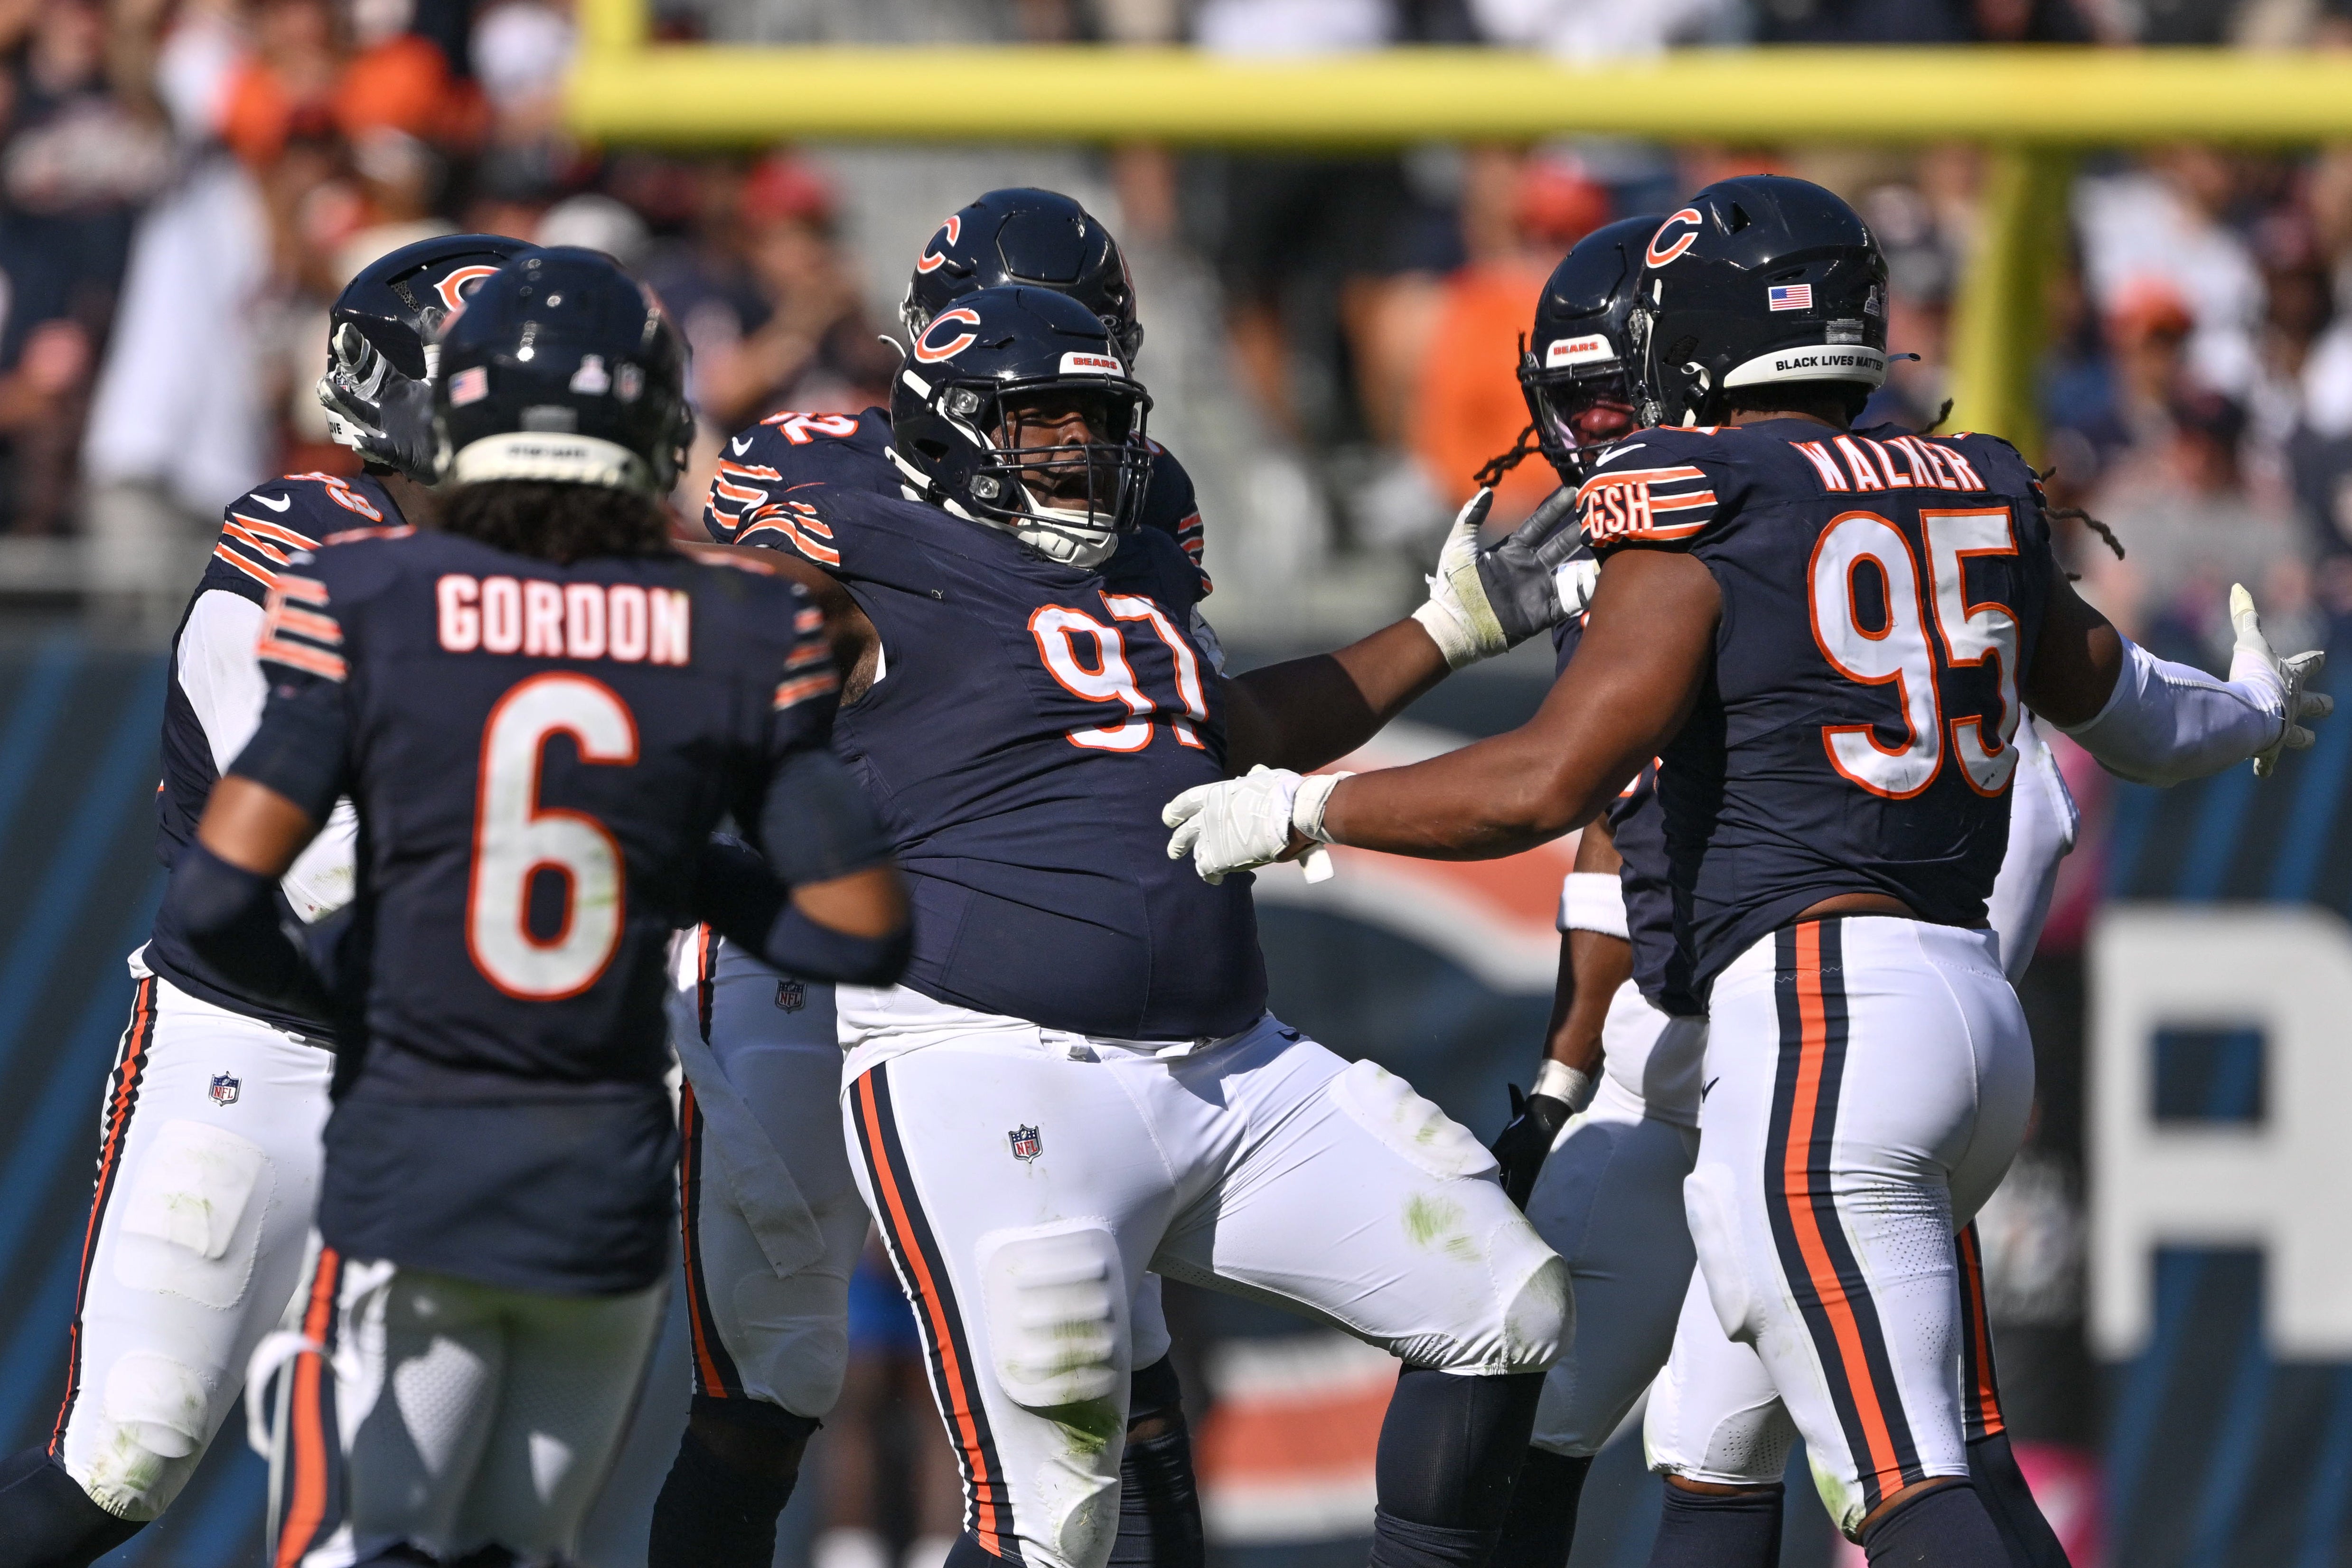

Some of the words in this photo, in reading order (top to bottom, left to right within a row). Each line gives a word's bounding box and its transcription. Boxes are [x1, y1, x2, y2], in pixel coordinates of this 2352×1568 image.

[1646, 208, 1702, 268] C
[914, 308, 981, 363] C
[1554, 341, 1598, 356] BEARS
[1073, 357, 1117, 370] BEARS
[1776, 357, 1818, 371] BLACK
[1822, 356, 1854, 366] LIVES
[1856, 357, 1884, 371] MATTER
[329, 421, 342, 434] OVE
[1790, 435, 1986, 492] WALKER
[1588, 482, 1653, 539] GSH
[435, 573, 691, 666] GORDON
[1027, 590, 1209, 752] 97
[1807, 507, 2019, 799] 95
[464, 670, 640, 1002] 6
[779, 992, 800, 1006] NFL
[214, 1086, 233, 1099] NFL
[1016, 1140, 1038, 1155] NFL
